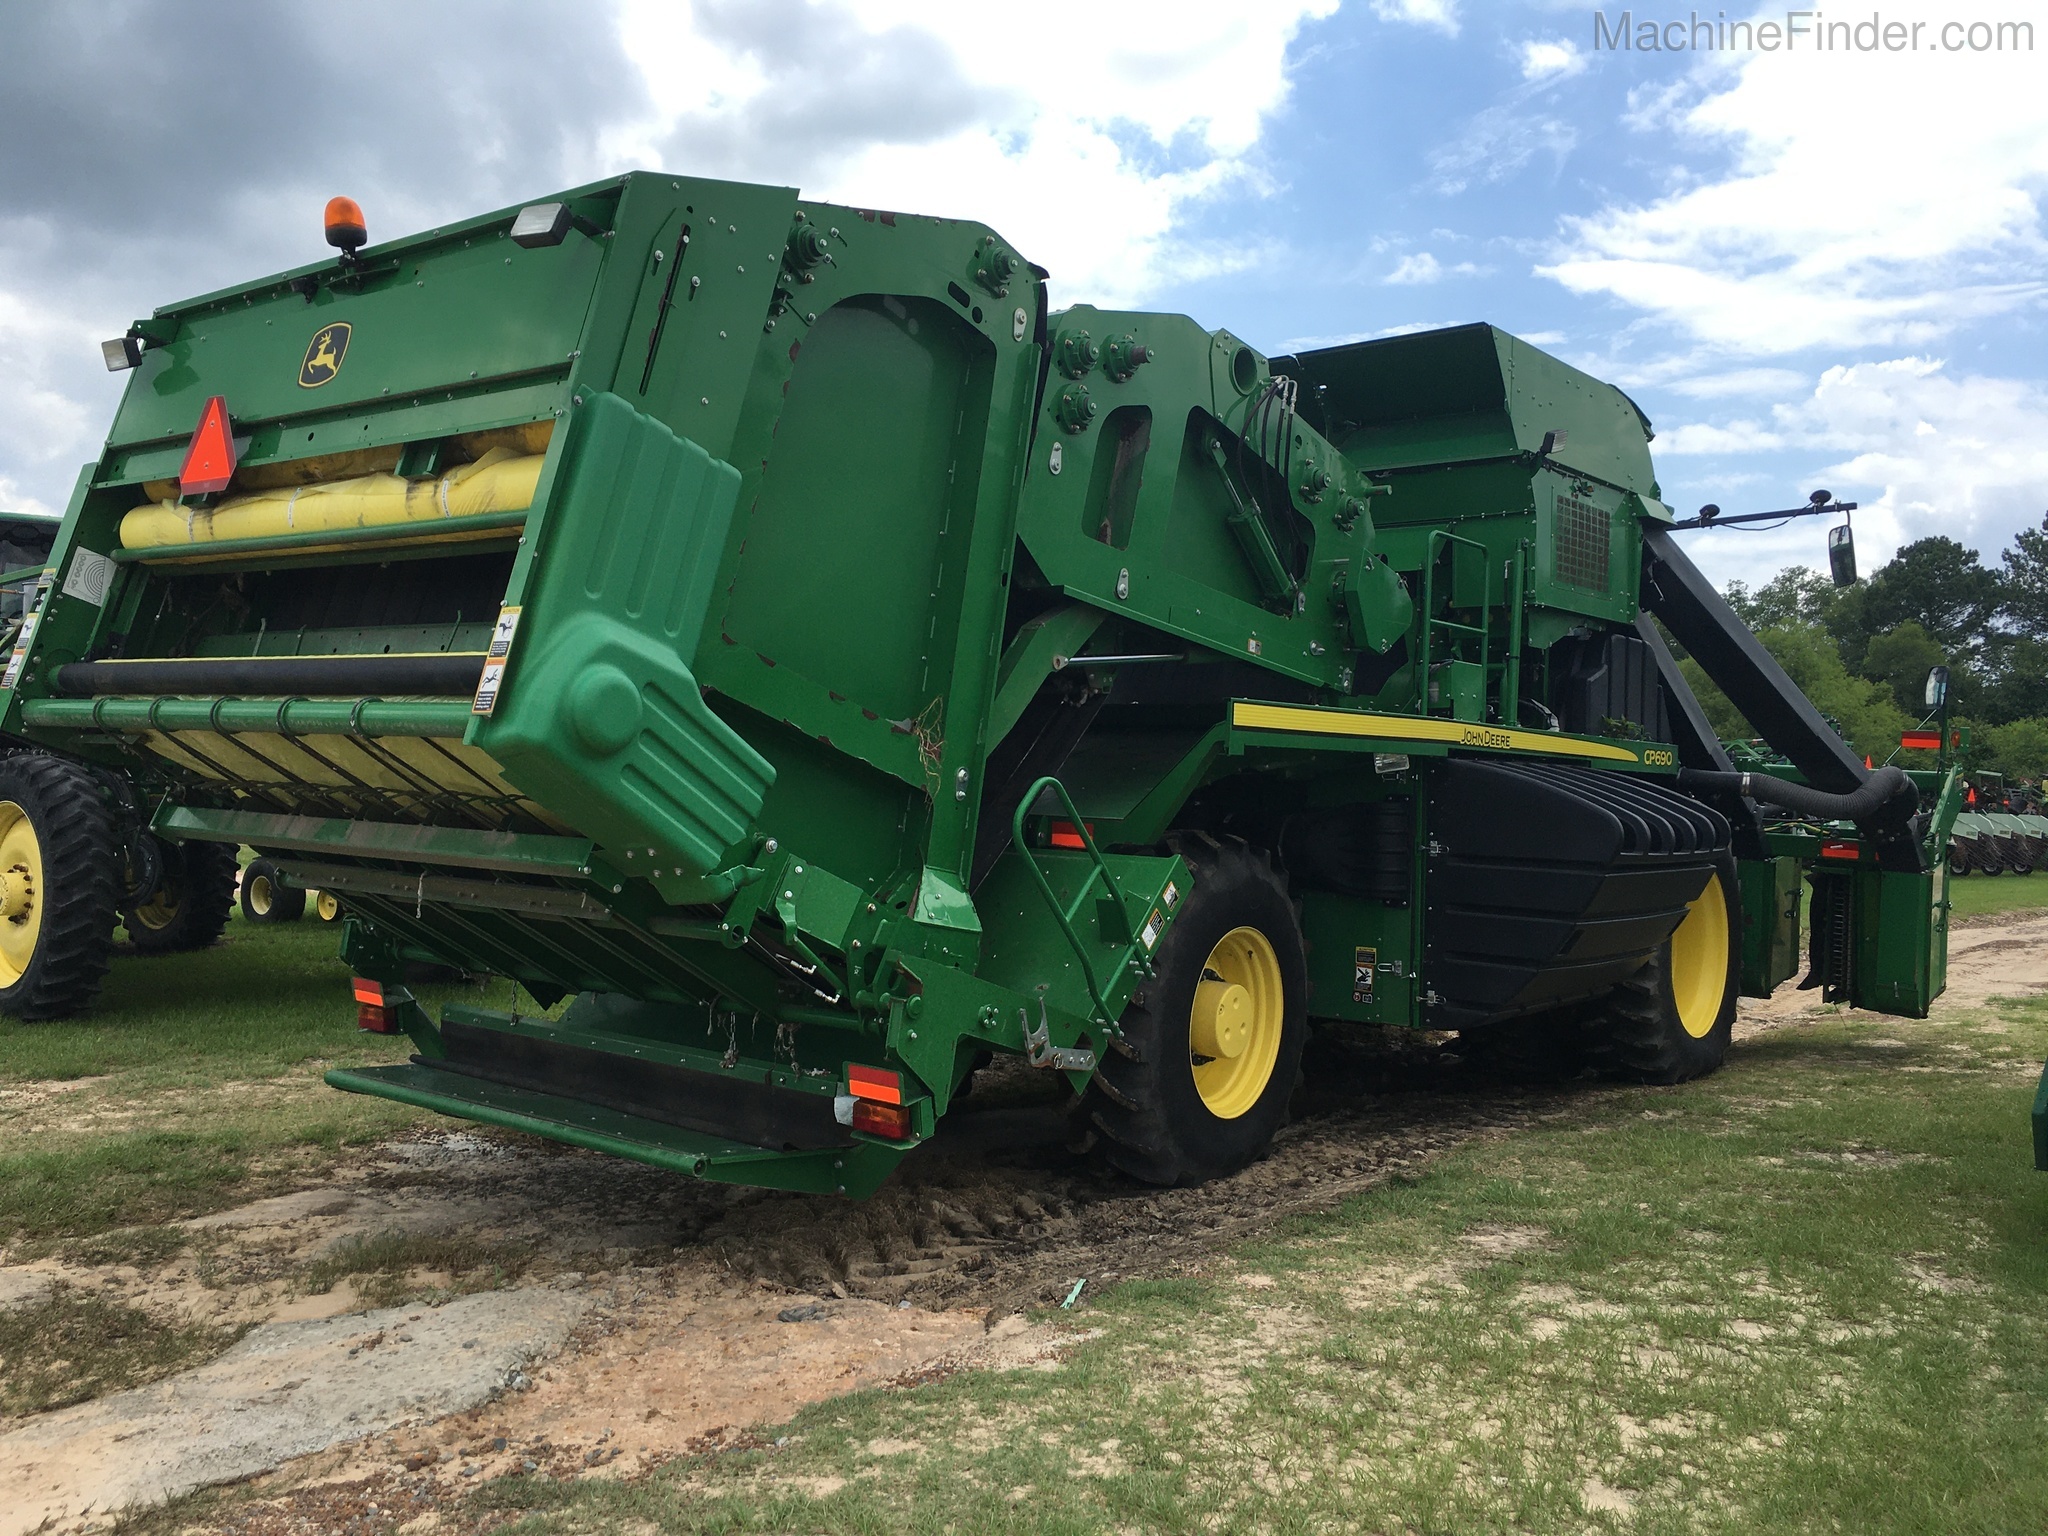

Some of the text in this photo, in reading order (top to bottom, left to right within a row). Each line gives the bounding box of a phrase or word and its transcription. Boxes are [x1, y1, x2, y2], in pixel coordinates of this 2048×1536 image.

[1460, 728, 1511, 748] JOHN DEERE
[1644, 749, 1673, 766] CP690
